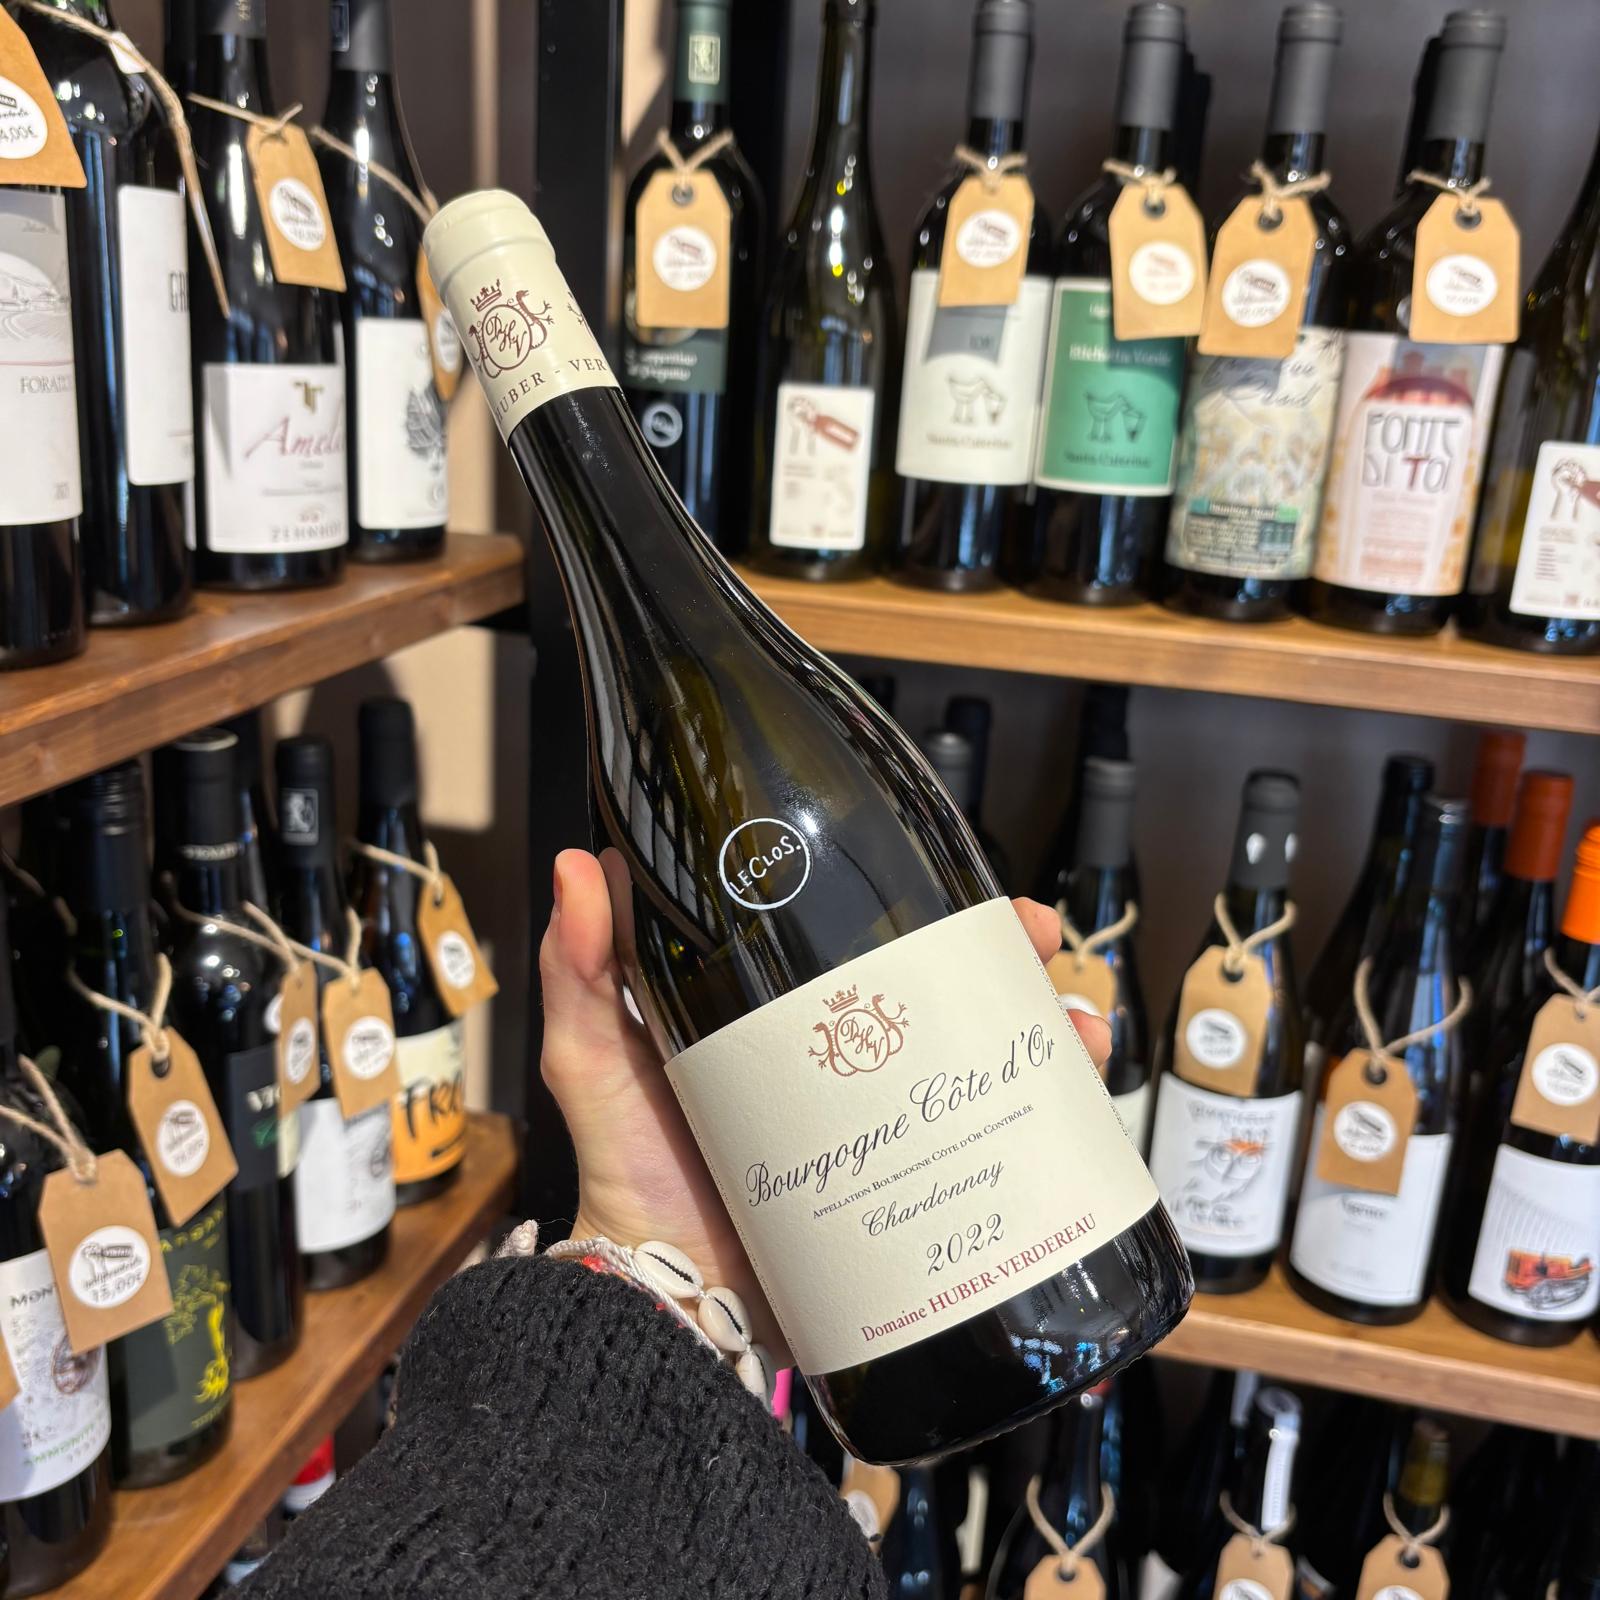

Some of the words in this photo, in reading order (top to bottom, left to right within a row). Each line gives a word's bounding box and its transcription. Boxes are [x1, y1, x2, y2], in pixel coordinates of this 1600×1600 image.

[745, 1113, 910, 1207] Bourgogne
[909, 1069, 993, 1123] Côte
[1002, 1023, 1055, 1084] d'Or
[812, 1186, 871, 1219] APPELLATION
[872, 1157, 932, 1191] BOURGOGNE
[983, 1103, 1034, 1135] CONTRÔLÉE
[861, 1160, 1005, 1237] Chardonnay
[926, 1213, 1005, 1277] 2022
[861, 1306, 928, 1342] Domaine
[927, 1212, 1097, 1314] HUBER-VERDEREAU
